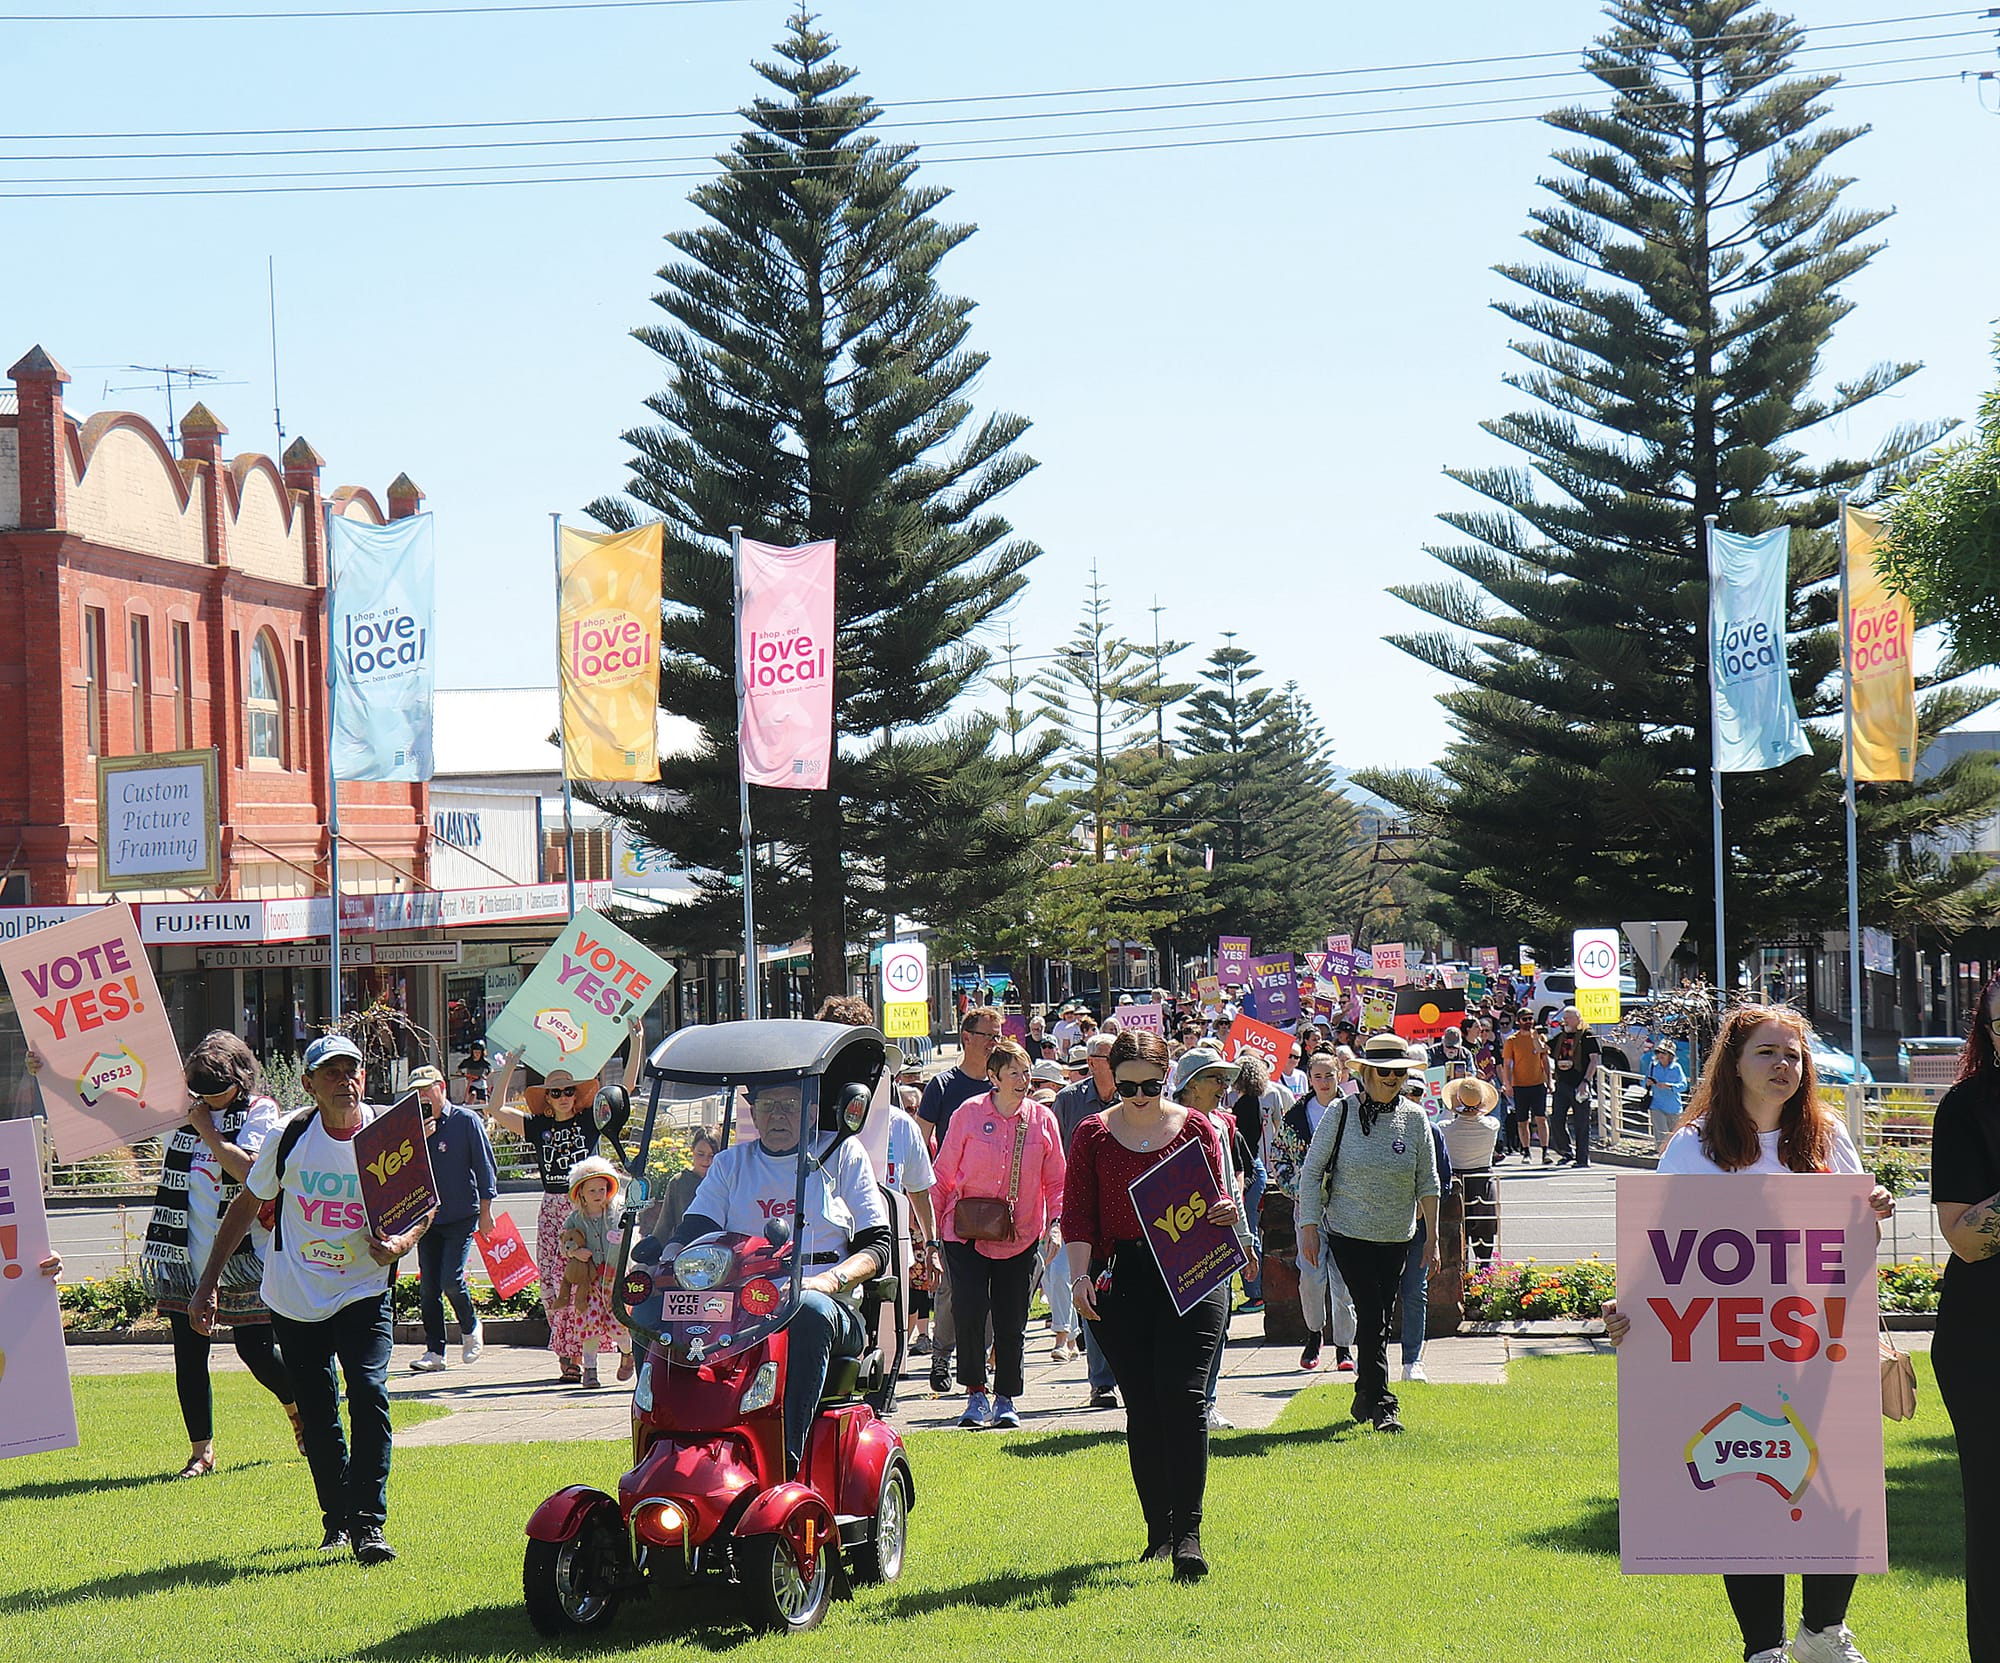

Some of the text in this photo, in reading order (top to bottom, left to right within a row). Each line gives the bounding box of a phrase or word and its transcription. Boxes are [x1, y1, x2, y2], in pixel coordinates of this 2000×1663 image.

[354, 606, 399, 622] shop eat
[584, 612, 626, 628] shop eat
[345, 614, 415, 648] love
[573, 620, 641, 652] love
[759, 627, 800, 640] shop eat
[1721, 621, 1768, 651] love
[1850, 608, 1899, 646] love
[346, 628, 426, 675] local
[573, 633, 650, 679] local
[750, 632, 813, 663] love
[1722, 633, 1780, 677] local
[1851, 623, 1907, 675] local
[750, 648, 825, 688] local
[122, 781, 189, 803] Custom
[122, 810, 190, 831] Picture
[116, 835, 198, 864] Framing
[156, 914, 251, 932] FUJIFILM
[1222, 943, 1247, 951] VOTE
[1330, 939, 1348, 947] VOTE
[205, 946, 361, 966] FOONSGIFTWRE
[1222, 951, 1246, 960] YES!
[1331, 955, 1349, 966] Vote
[1376, 950, 1401, 959] VOTE
[1376, 959, 1401, 968] YES!
[1583, 949, 1610, 968] 40
[21, 938, 131, 999] VOTE
[574, 931, 652, 1000] VOTE
[892, 963, 918, 983] 40
[1255, 961, 1291, 976] VOTE
[1326, 961, 1350, 976] YES
[556, 953, 635, 1024] YES!
[1202, 985, 1215, 994] Yes
[1256, 973, 1292, 988] YES!
[33, 975, 145, 1041] YES!
[1316, 1003, 1330, 1013] Yes
[1585, 993, 1610, 1003] NEW
[893, 1008, 919, 1017] NEW
[1121, 1014, 1157, 1026] VOTE
[1582, 1007, 1614, 1017] LIMIT
[546, 1015, 578, 1041] yes23
[891, 1020, 921, 1031] LIMIT
[1245, 1028, 1276, 1052] Vote
[91, 1065, 133, 1089] yes23
[366, 1138, 414, 1186] Yes
[300, 1170, 358, 1198] VOT
[297, 1195, 366, 1230] YES
[378, 1185, 425, 1223] A meaningful step
[757, 1199, 797, 1218] Yes
[383, 1218, 393, 1228] the
[392, 1207, 406, 1220] right
[1153, 1191, 1207, 1243] Yes
[145, 1243, 185, 1261] MAGPIES
[312, 1248, 345, 1262] yes23
[487, 1238, 517, 1265] Yes
[1646, 1228, 1846, 1285] VOTE
[1177, 1247, 1236, 1294] in the right direction.
[1178, 1242, 1228, 1284] A meaningful step
[626, 1281, 645, 1294] Yes
[750, 1288, 770, 1303] Yes
[668, 1304, 698, 1315] YES!
[669, 1294, 700, 1304] VOTE
[1645, 1295, 1848, 1363] YES!
[1714, 1439, 1792, 1464] yes23
